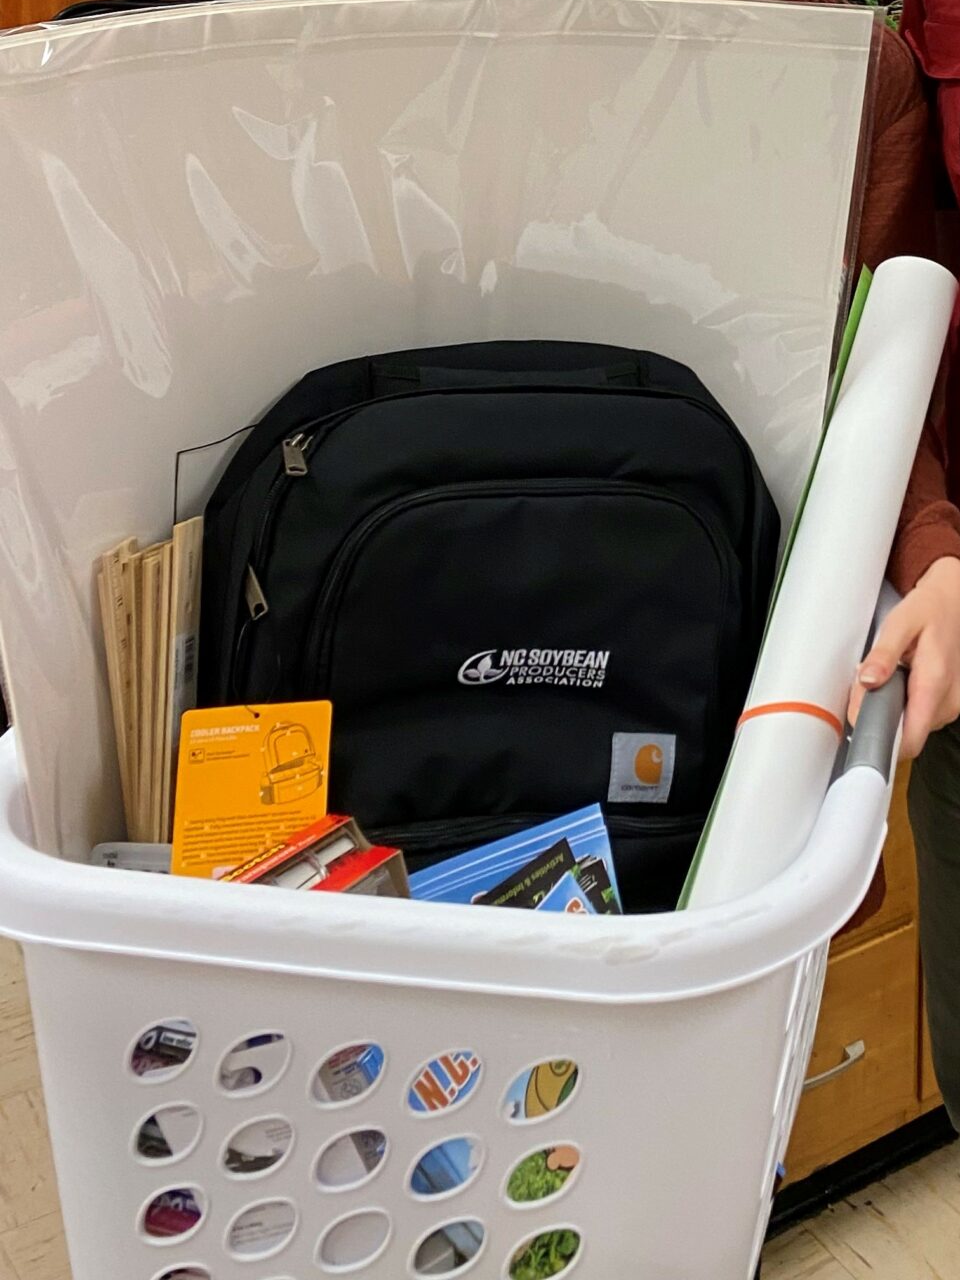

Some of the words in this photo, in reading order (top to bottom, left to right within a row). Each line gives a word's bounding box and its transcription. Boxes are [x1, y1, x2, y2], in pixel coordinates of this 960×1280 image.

[500, 649, 527, 667] NC
[527, 649, 610, 669] SOYBEAN
[509, 666, 606, 680] PRODUCERS
[506, 676, 604, 688] ASSOCIATION
